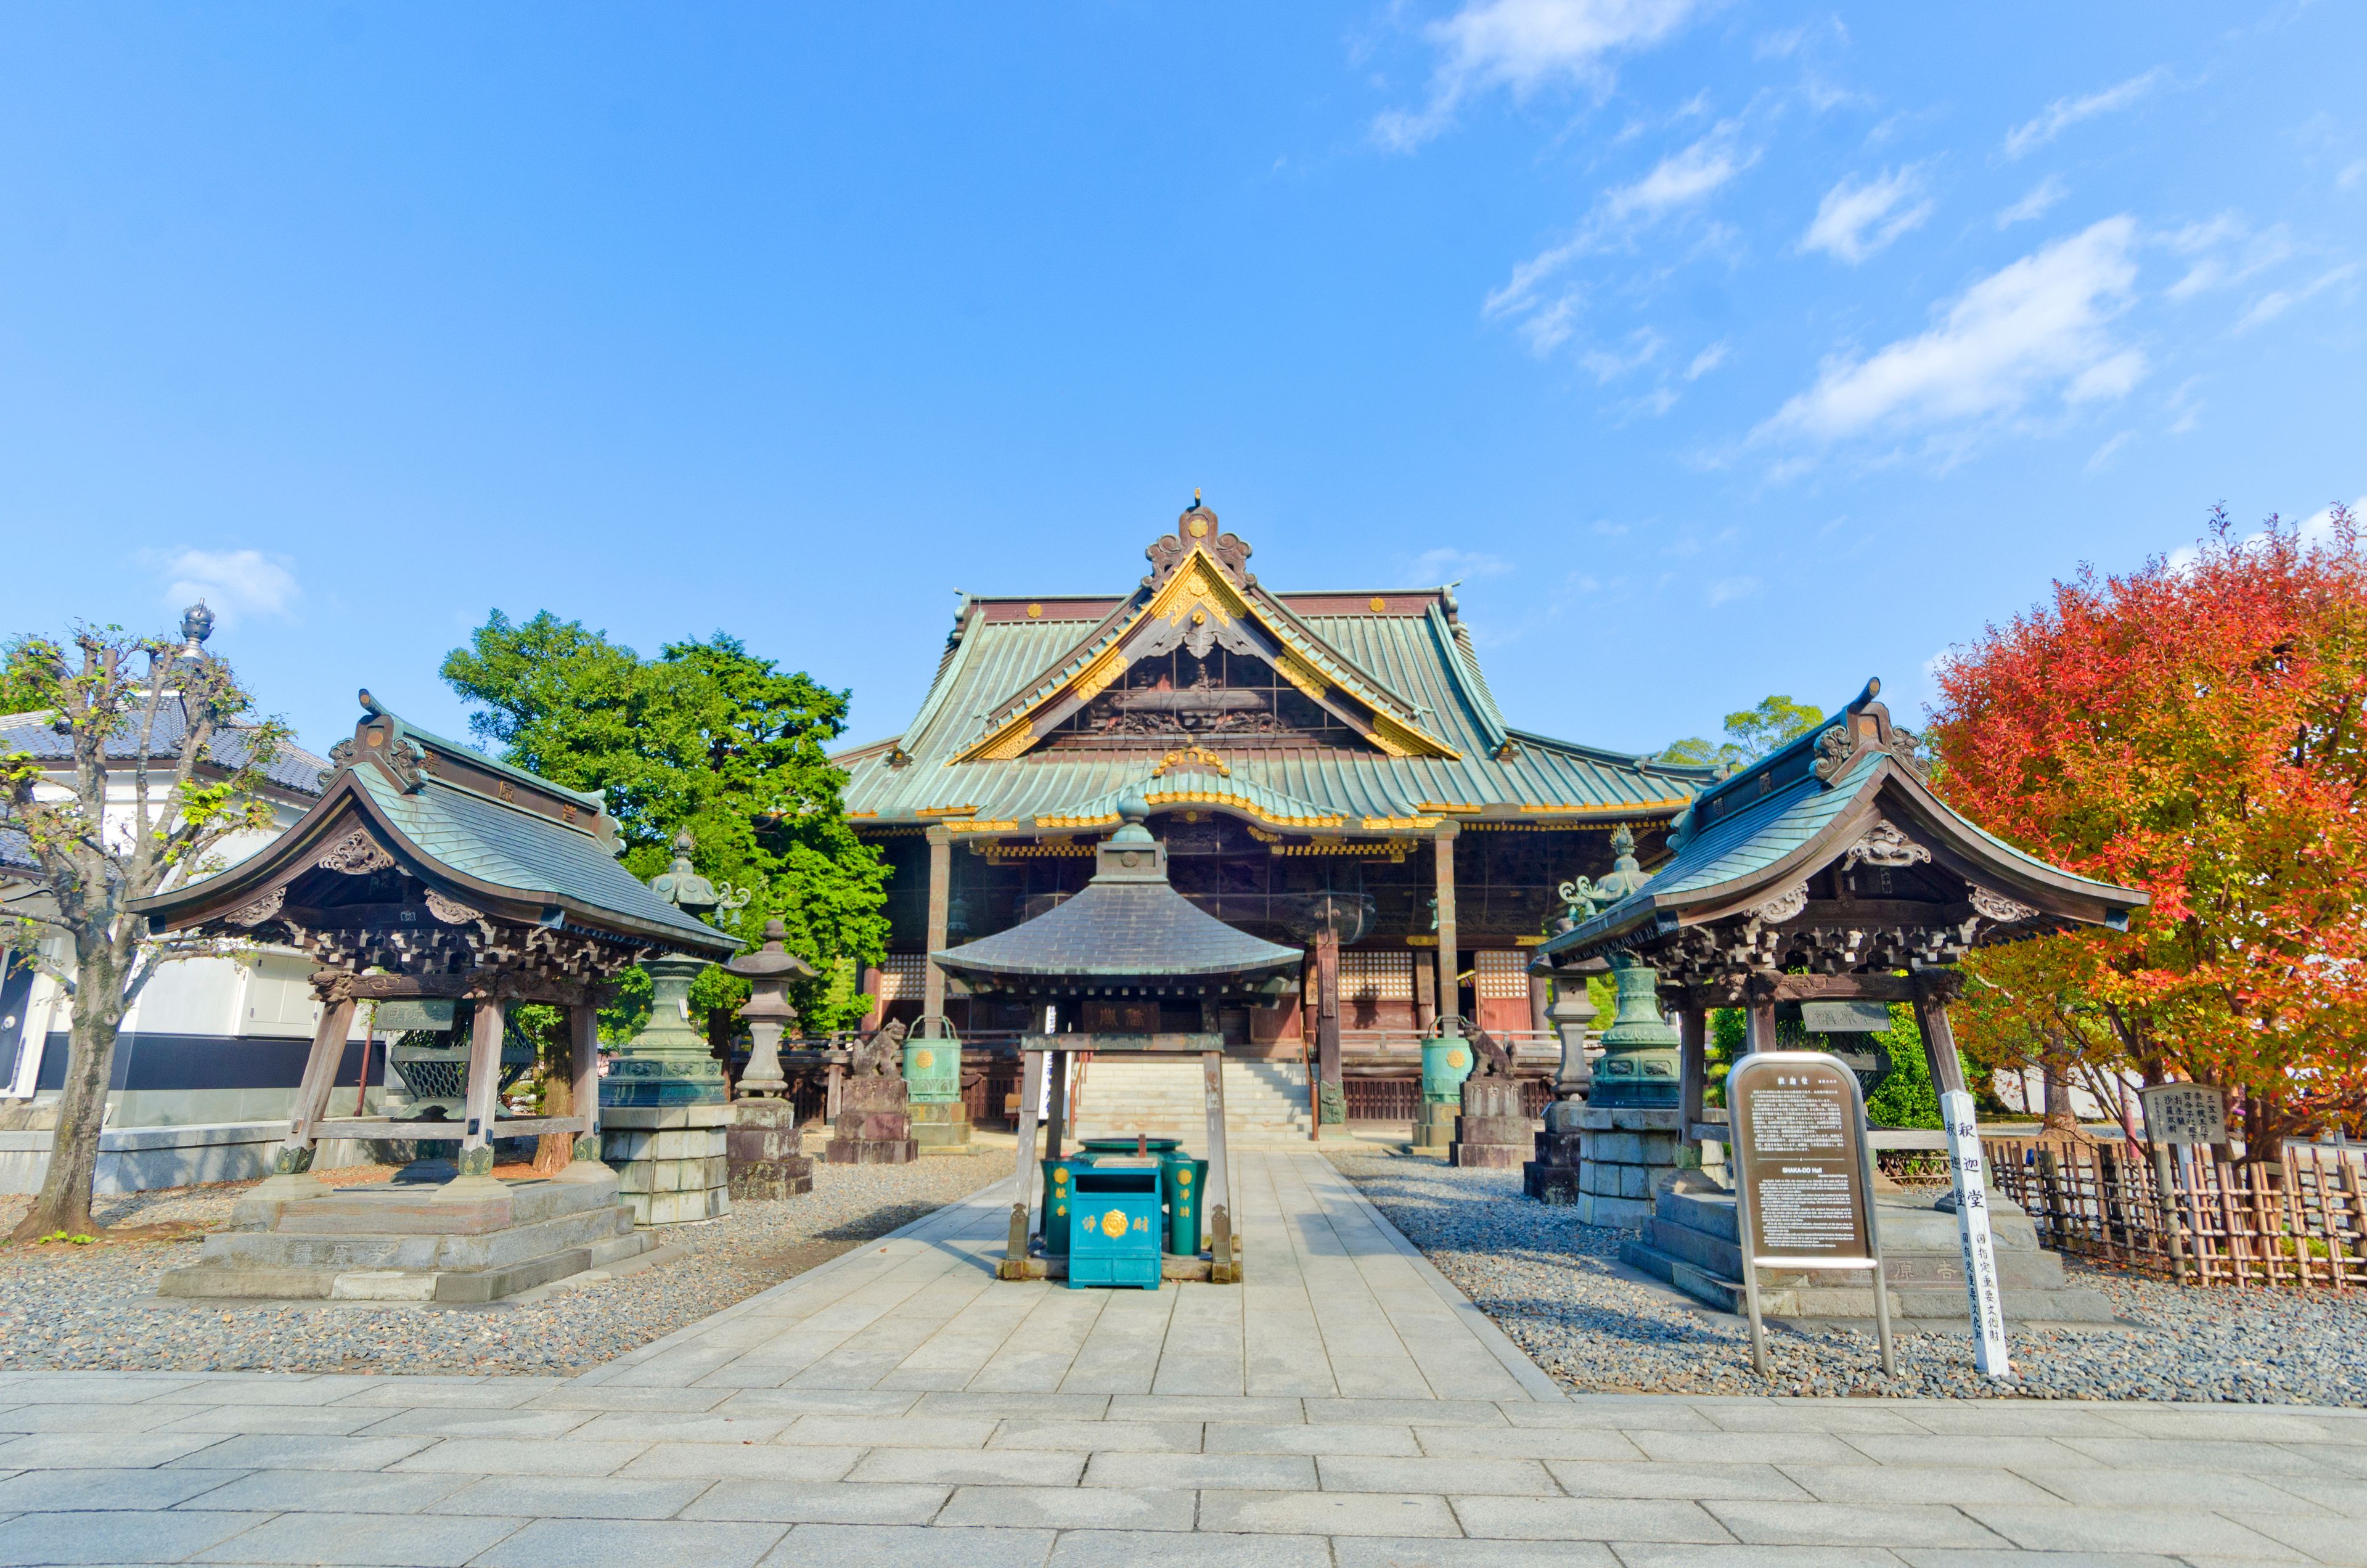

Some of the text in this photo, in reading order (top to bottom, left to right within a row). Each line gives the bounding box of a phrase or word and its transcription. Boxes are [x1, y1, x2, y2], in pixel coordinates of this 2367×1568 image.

[2207, 1095, 2218, 1124] 三笠宮
[1957, 1122, 2000, 1342] 釈迦堂 国指定重要文化財
